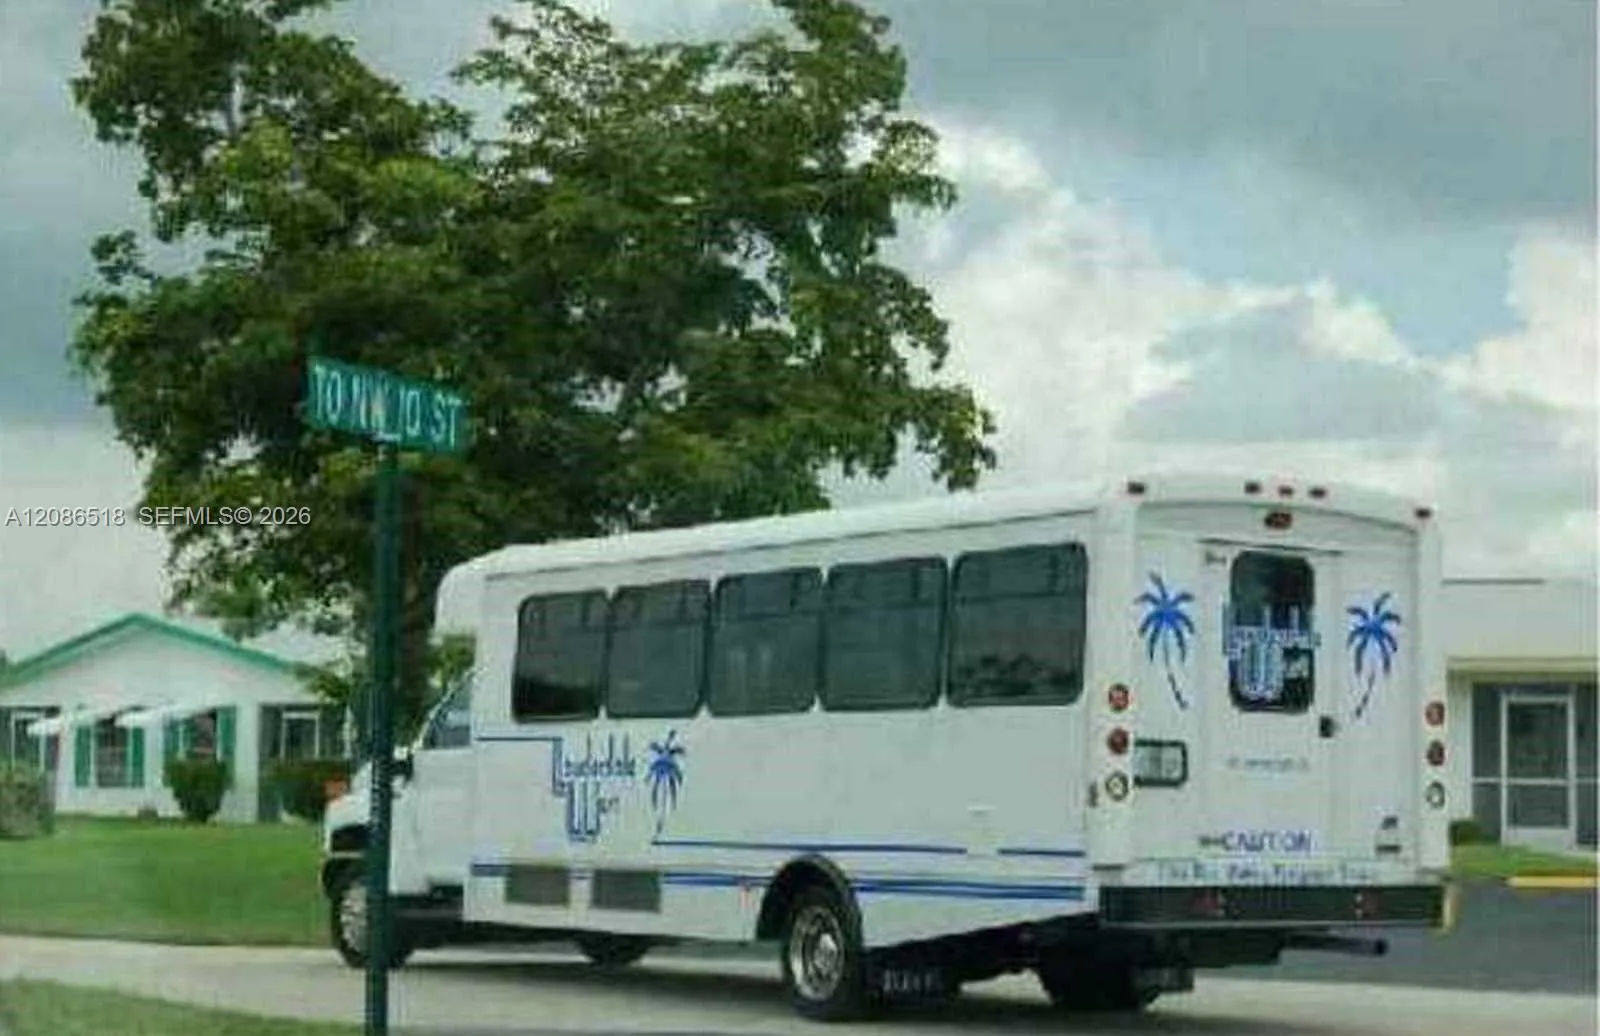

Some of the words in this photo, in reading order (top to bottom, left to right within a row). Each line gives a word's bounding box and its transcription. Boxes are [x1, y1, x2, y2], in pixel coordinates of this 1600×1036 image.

[314, 363, 342, 425] TO
[399, 385, 421, 437] 10
[430, 391, 462, 449] ST
